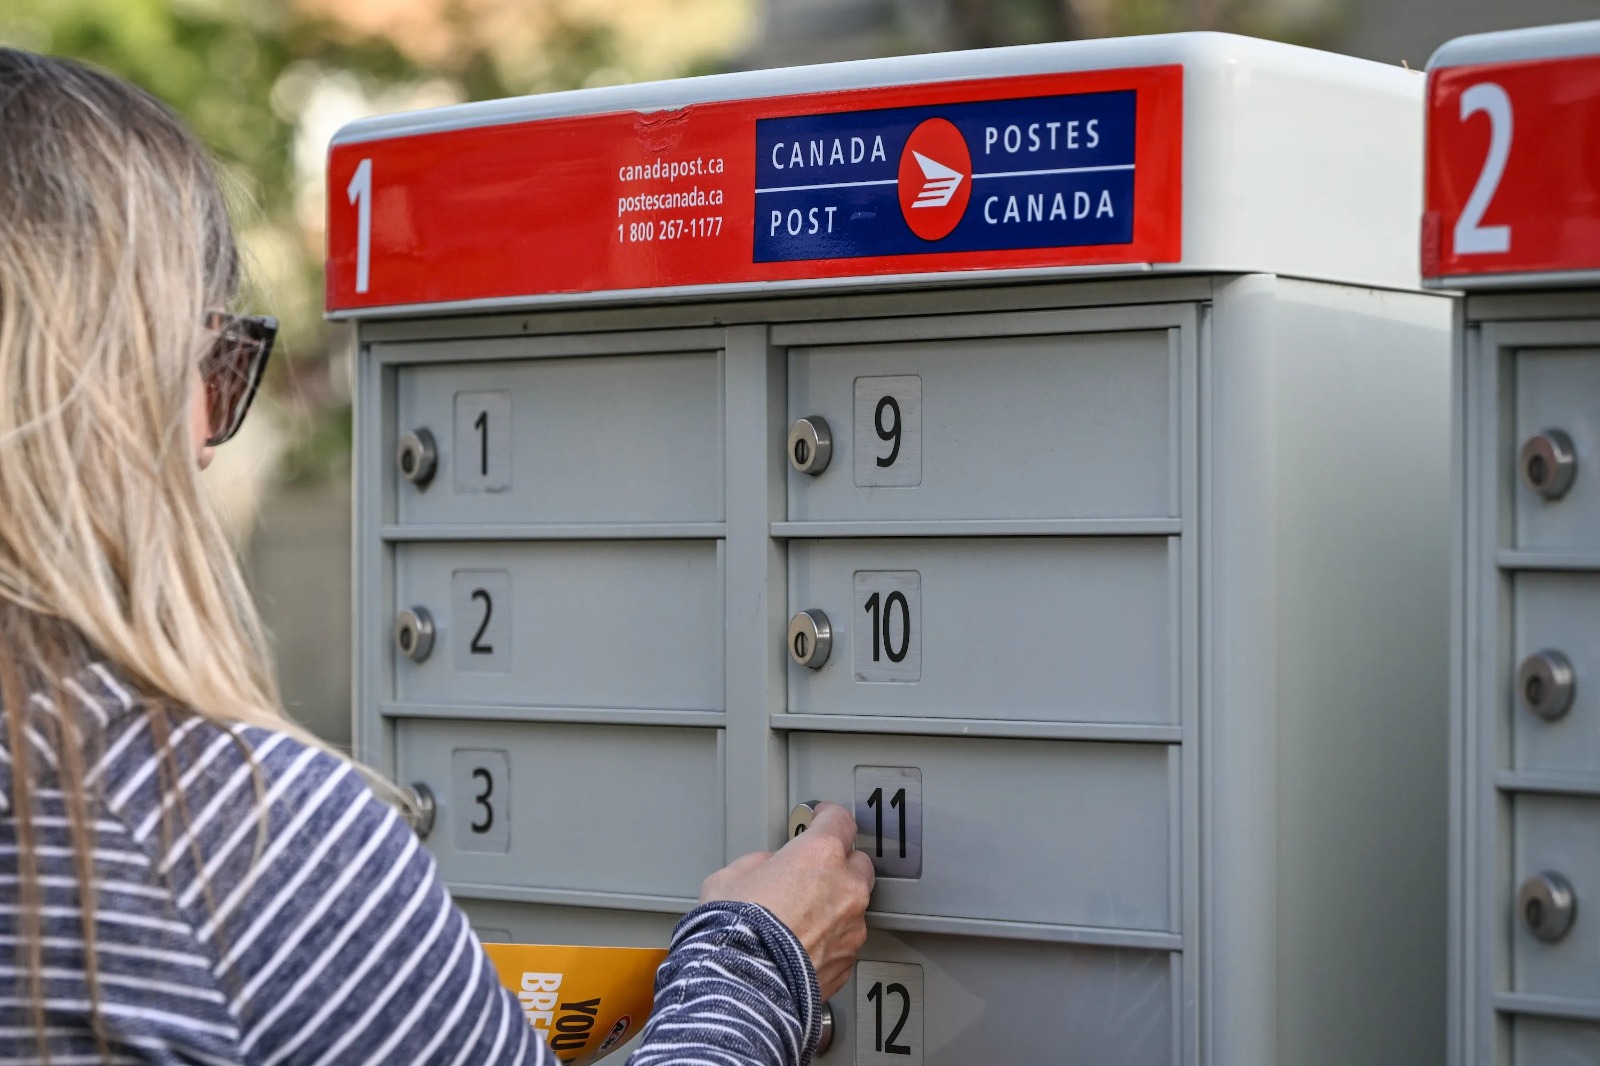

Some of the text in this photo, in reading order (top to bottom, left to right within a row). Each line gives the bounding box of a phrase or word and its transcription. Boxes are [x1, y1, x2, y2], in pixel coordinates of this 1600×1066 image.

[772, 135, 886, 170] CANADA
[985, 119, 1099, 154] POSTES
[1454, 83, 1513, 254] 2
[618, 185, 723, 217] postescanada.ca
[619, 157, 724, 182] canadapost.ca
[347, 159, 372, 293] 1
[617, 216, 723, 243] 1 800 267-1177
[770, 206, 837, 237] POST
[984, 190, 1114, 224] CANADA
[474, 411, 488, 476] 1
[874, 396, 902, 468] 9
[470, 589, 493, 654] 2
[864, 591, 911, 663] 10
[471, 768, 494, 834] 3
[866, 787, 907, 859] 11
[517, 971, 563, 1041] BRE
[866, 981, 911, 1056] 12
